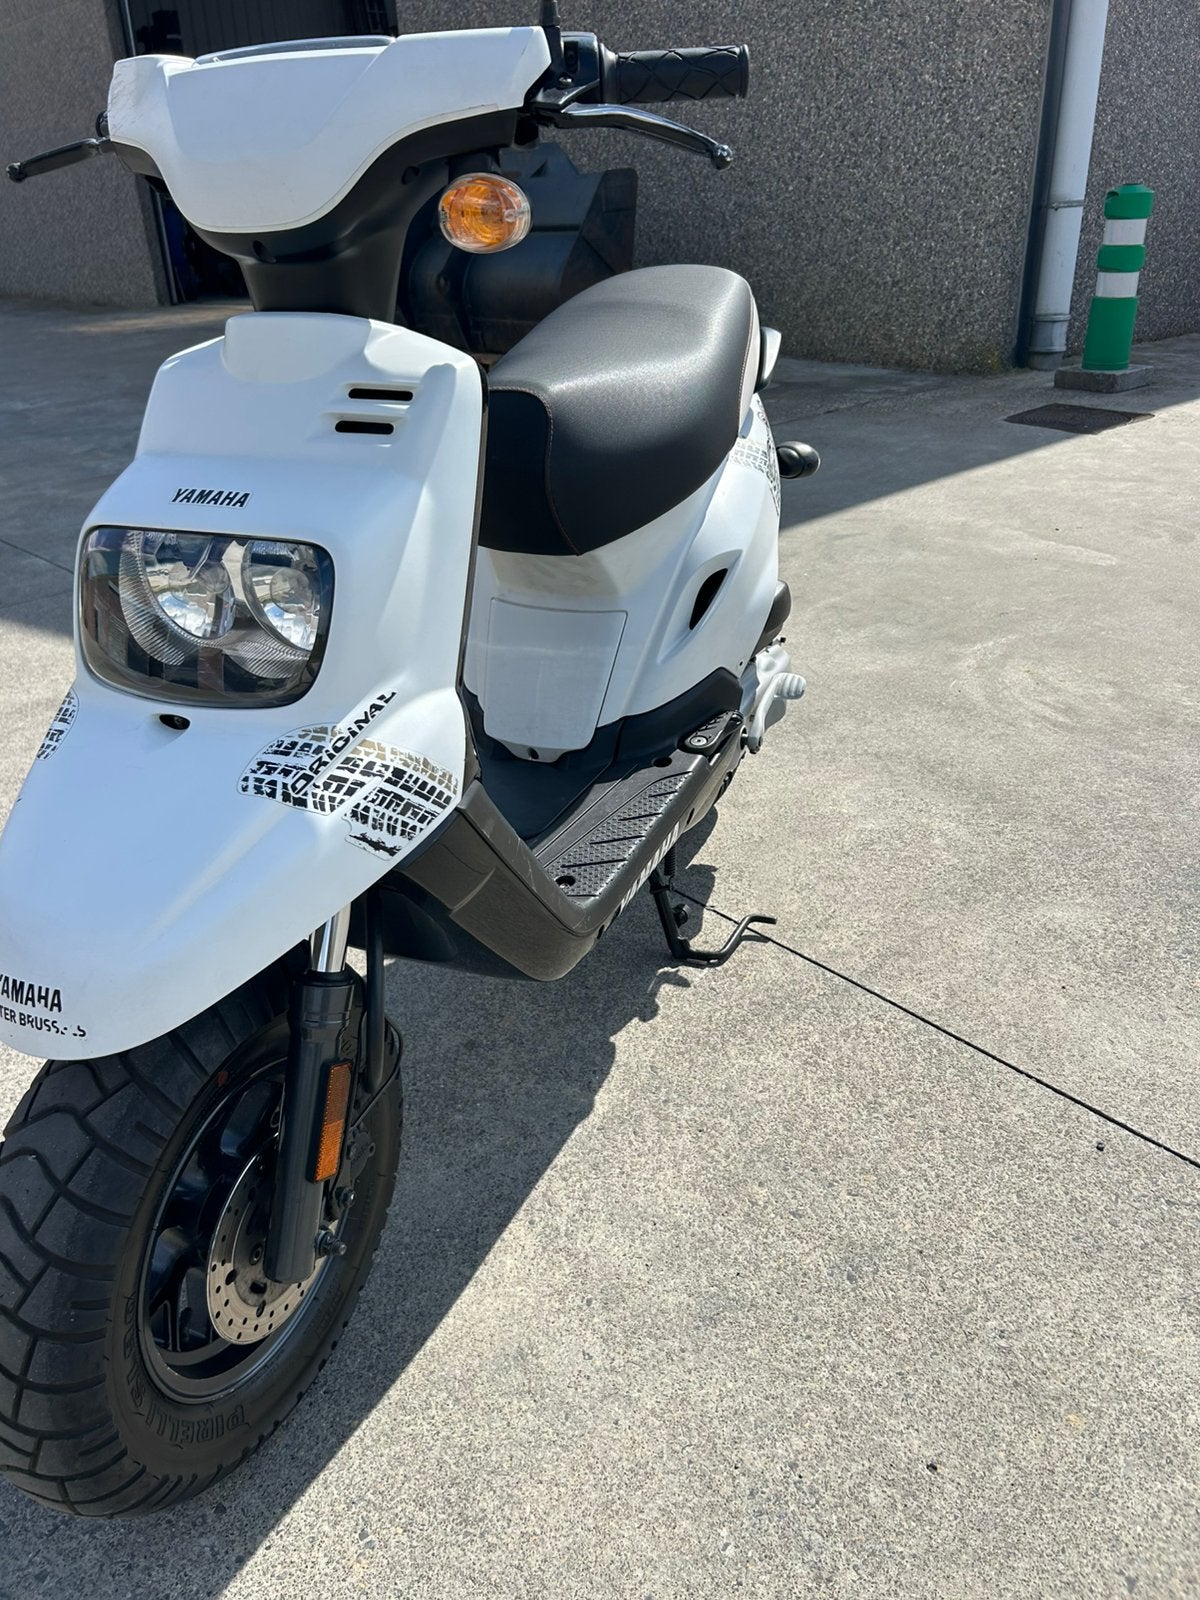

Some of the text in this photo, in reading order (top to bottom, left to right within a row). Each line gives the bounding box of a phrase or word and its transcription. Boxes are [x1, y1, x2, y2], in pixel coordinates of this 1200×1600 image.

[171, 488, 250, 508] YAMAHA
[290, 691, 397, 797] ORIGINAL
[145, 1402, 252, 1445] PIRELLI
